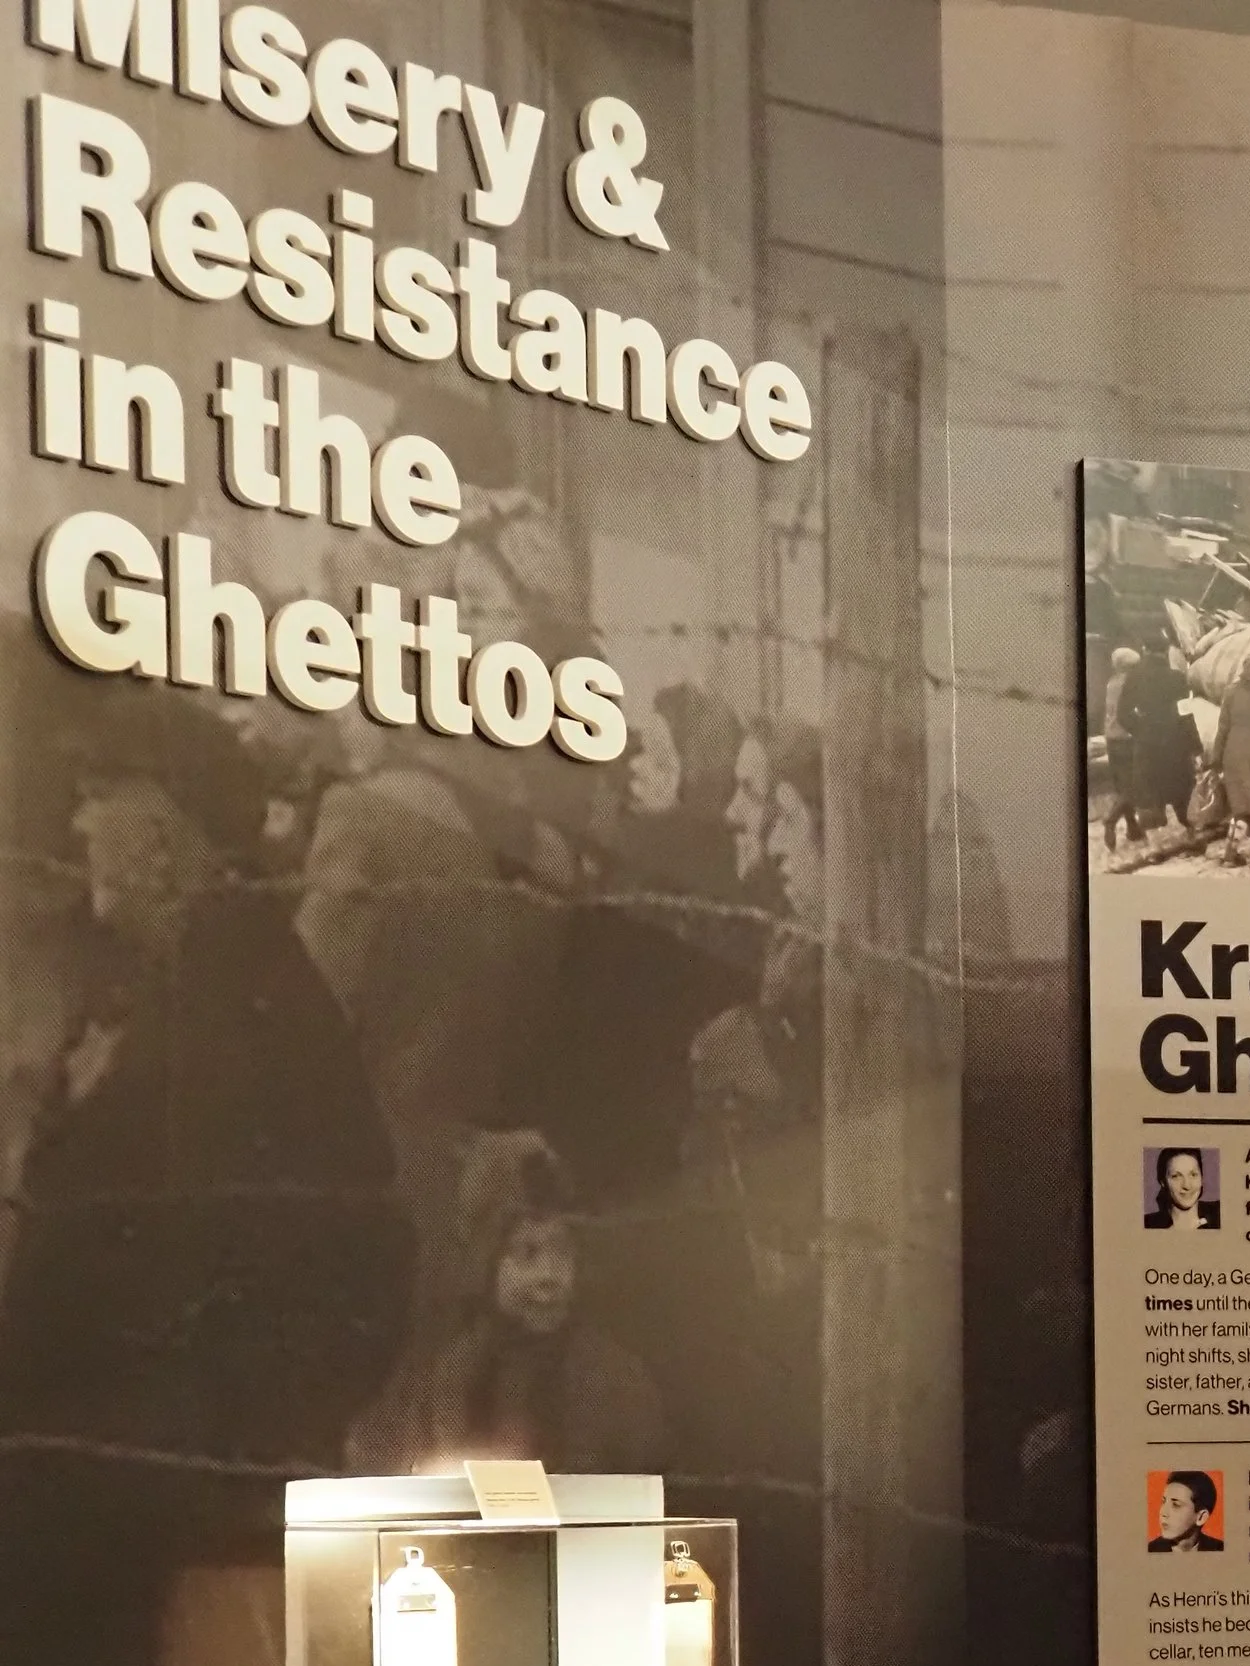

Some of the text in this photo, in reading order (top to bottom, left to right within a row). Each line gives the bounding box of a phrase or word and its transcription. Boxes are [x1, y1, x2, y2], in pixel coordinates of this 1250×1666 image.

[566, 96, 670, 251] &
[31, 91, 812, 462] Resistance
[34, 300, 461, 545] in the
[37, 512, 627, 762] Ghettos
[1145, 1268, 1180, 1286] One
[1183, 1269, 1215, 1288] day,
[1144, 1294, 1193, 1312] times
[1196, 1294, 1228, 1312] until
[1145, 1321, 1178, 1337] with
[1182, 1322, 1208, 1338] her
[1146, 1347, 1185, 1367] night
[1189, 1347, 1234, 1365] shifts,
[1146, 1374, 1192, 1391] sister,
[1196, 1373, 1244, 1391] father,
[1145, 1400, 1224, 1416] Germans.
[1148, 1592, 1171, 1608] As
[1149, 1618, 1199, 1634] insists
[1202, 1617, 1222, 1632] he
[1147, 1644, 1195, 1662] cellar,
[1198, 1644, 1224, 1662] ten
